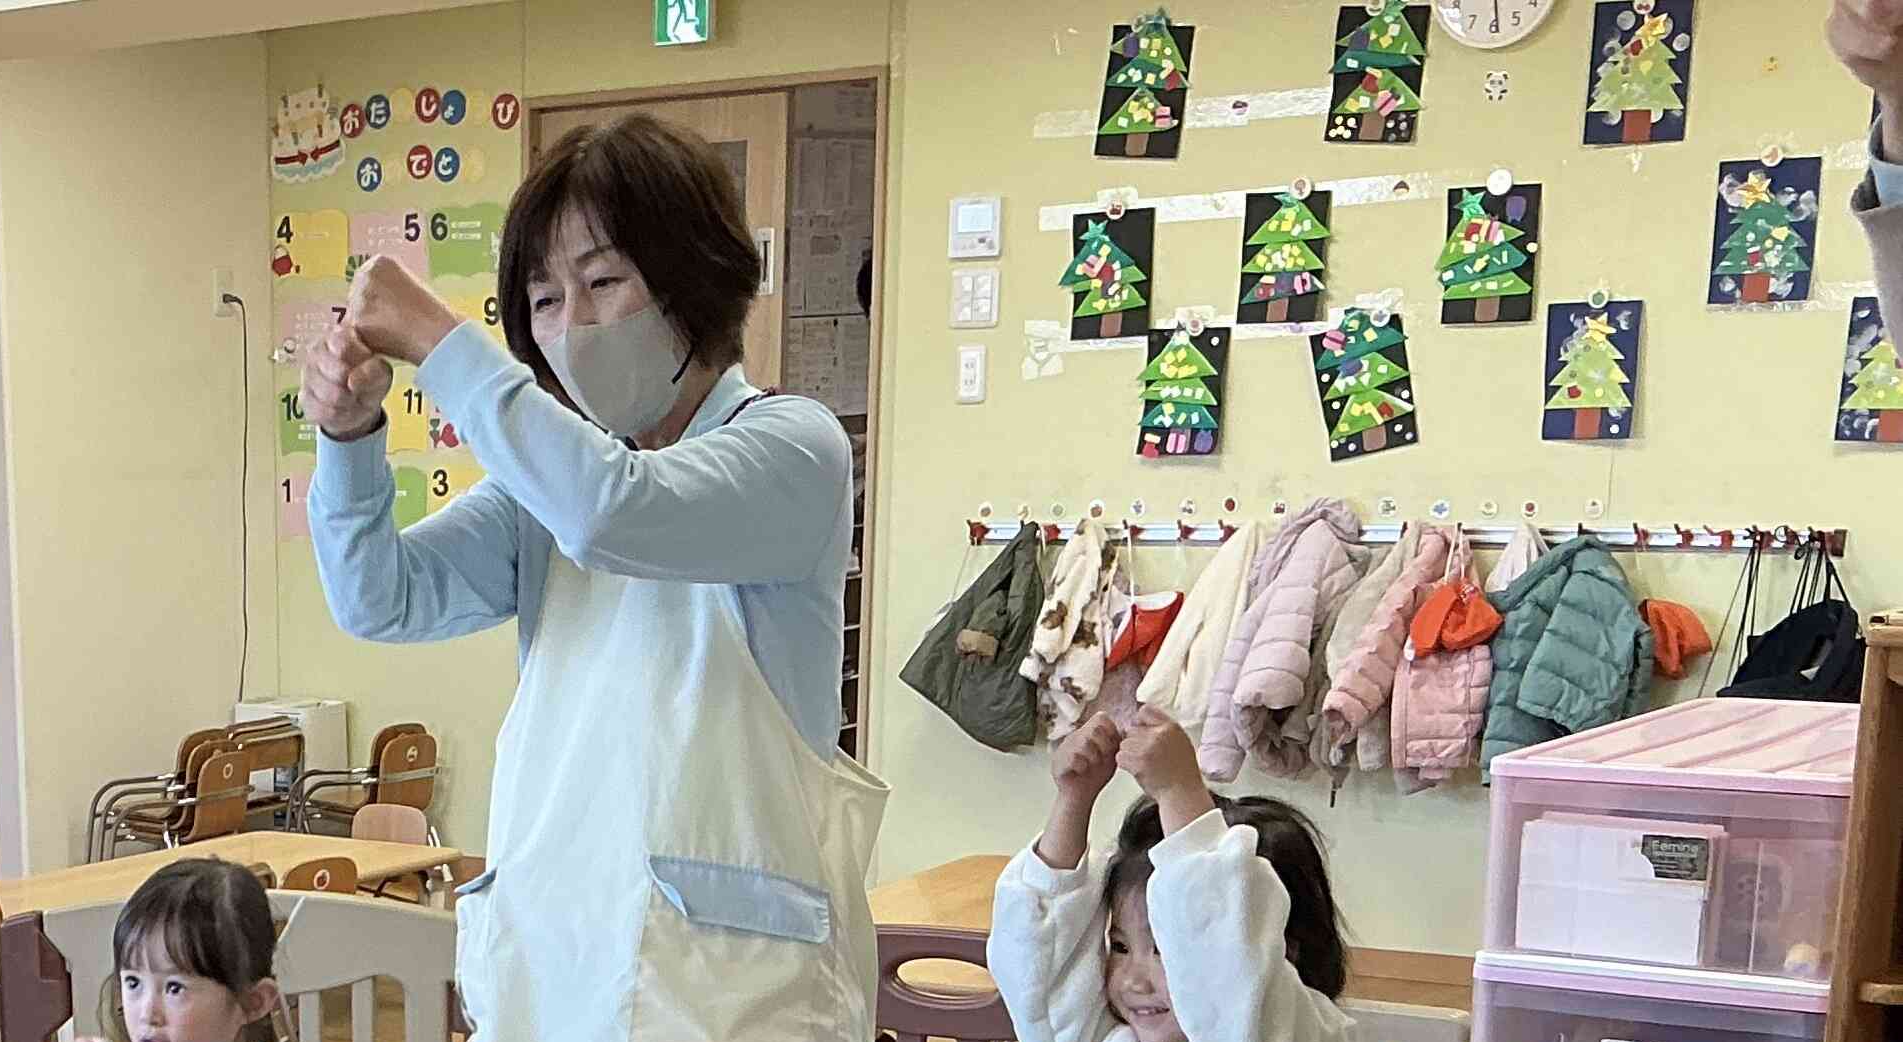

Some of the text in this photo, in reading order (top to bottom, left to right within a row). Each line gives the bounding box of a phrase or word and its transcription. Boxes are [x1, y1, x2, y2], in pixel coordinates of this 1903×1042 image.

[1467, 14, 1477, 30] 7
[1511, 10, 1521, 26] 5
[276, 215, 294, 244] 4
[404, 213, 421, 242] 5
[430, 212, 449, 241] 6
[331, 307, 347, 325] 7
[484, 296, 500, 326] 9
[403, 388, 424, 415] 11
[282, 478, 292, 503] 1
[432, 469, 450, 497] 3
